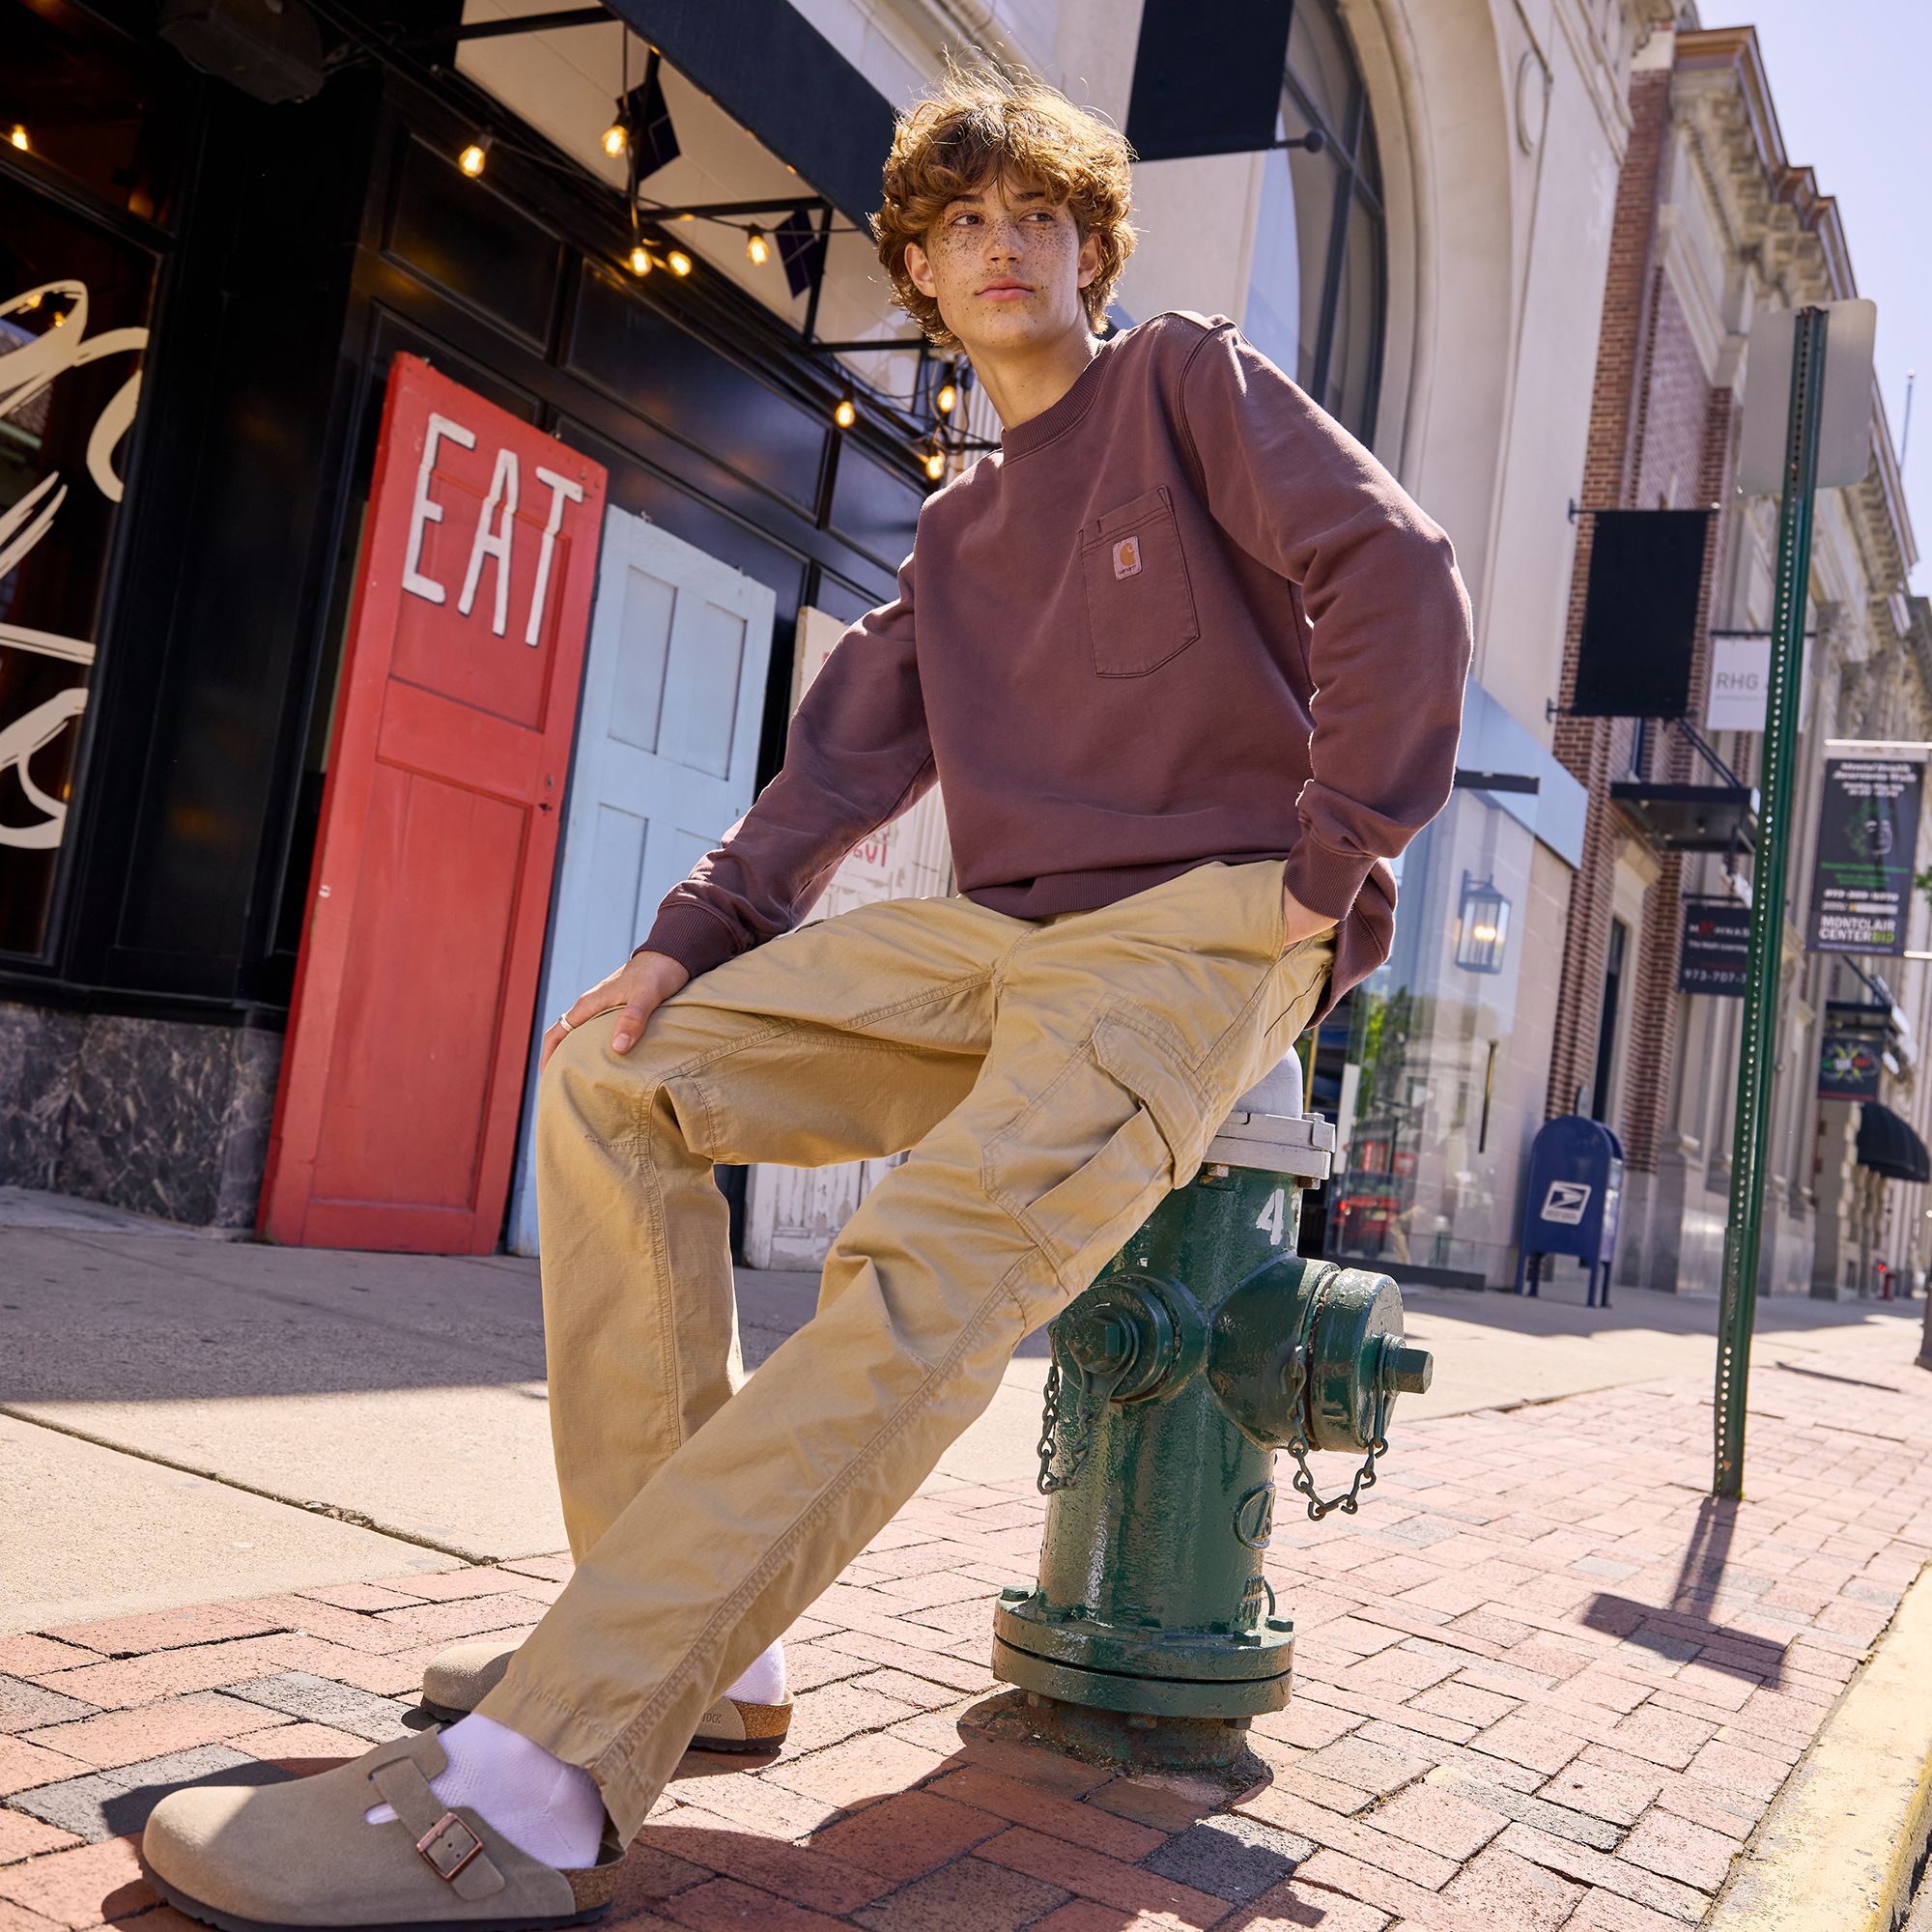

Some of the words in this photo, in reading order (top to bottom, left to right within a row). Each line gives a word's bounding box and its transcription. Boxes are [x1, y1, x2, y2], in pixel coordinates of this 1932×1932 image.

[401, 412, 583, 648] EAT
[1716, 671, 1759, 690] RHG
[1821, 915, 1896, 932] MONTCLAIR
